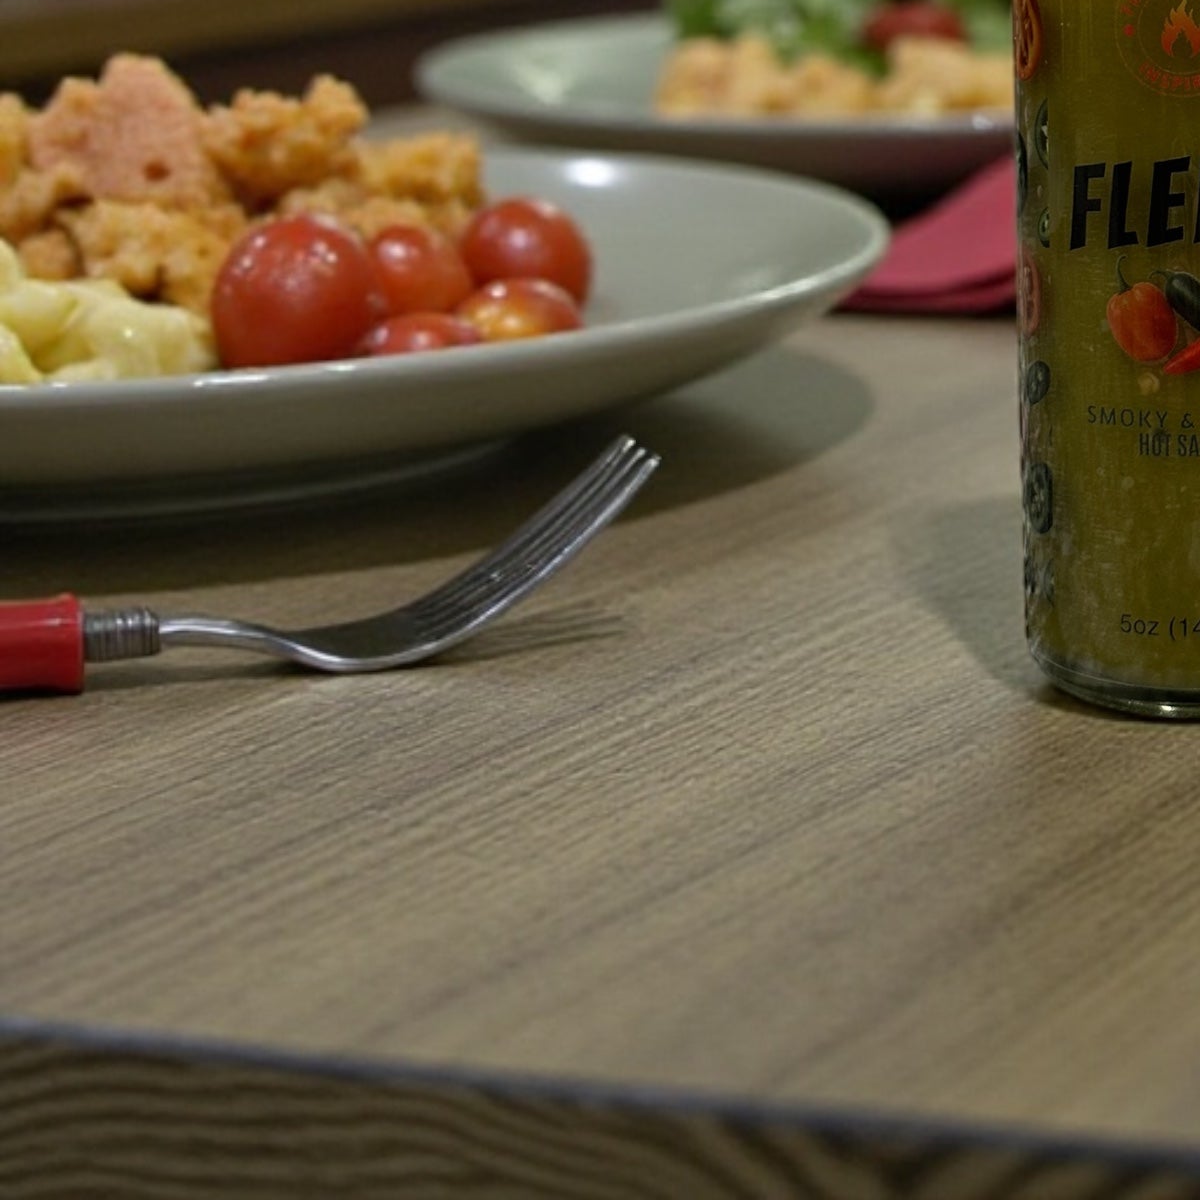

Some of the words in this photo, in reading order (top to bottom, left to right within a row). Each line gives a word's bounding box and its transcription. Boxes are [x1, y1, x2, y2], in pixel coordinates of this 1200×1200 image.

[1087, 405, 1168, 429] SMOKY
[1180, 412, 1195, 429] &
[1138, 432, 1172, 458] HOT
[1120, 614, 1160, 637] 5oz
